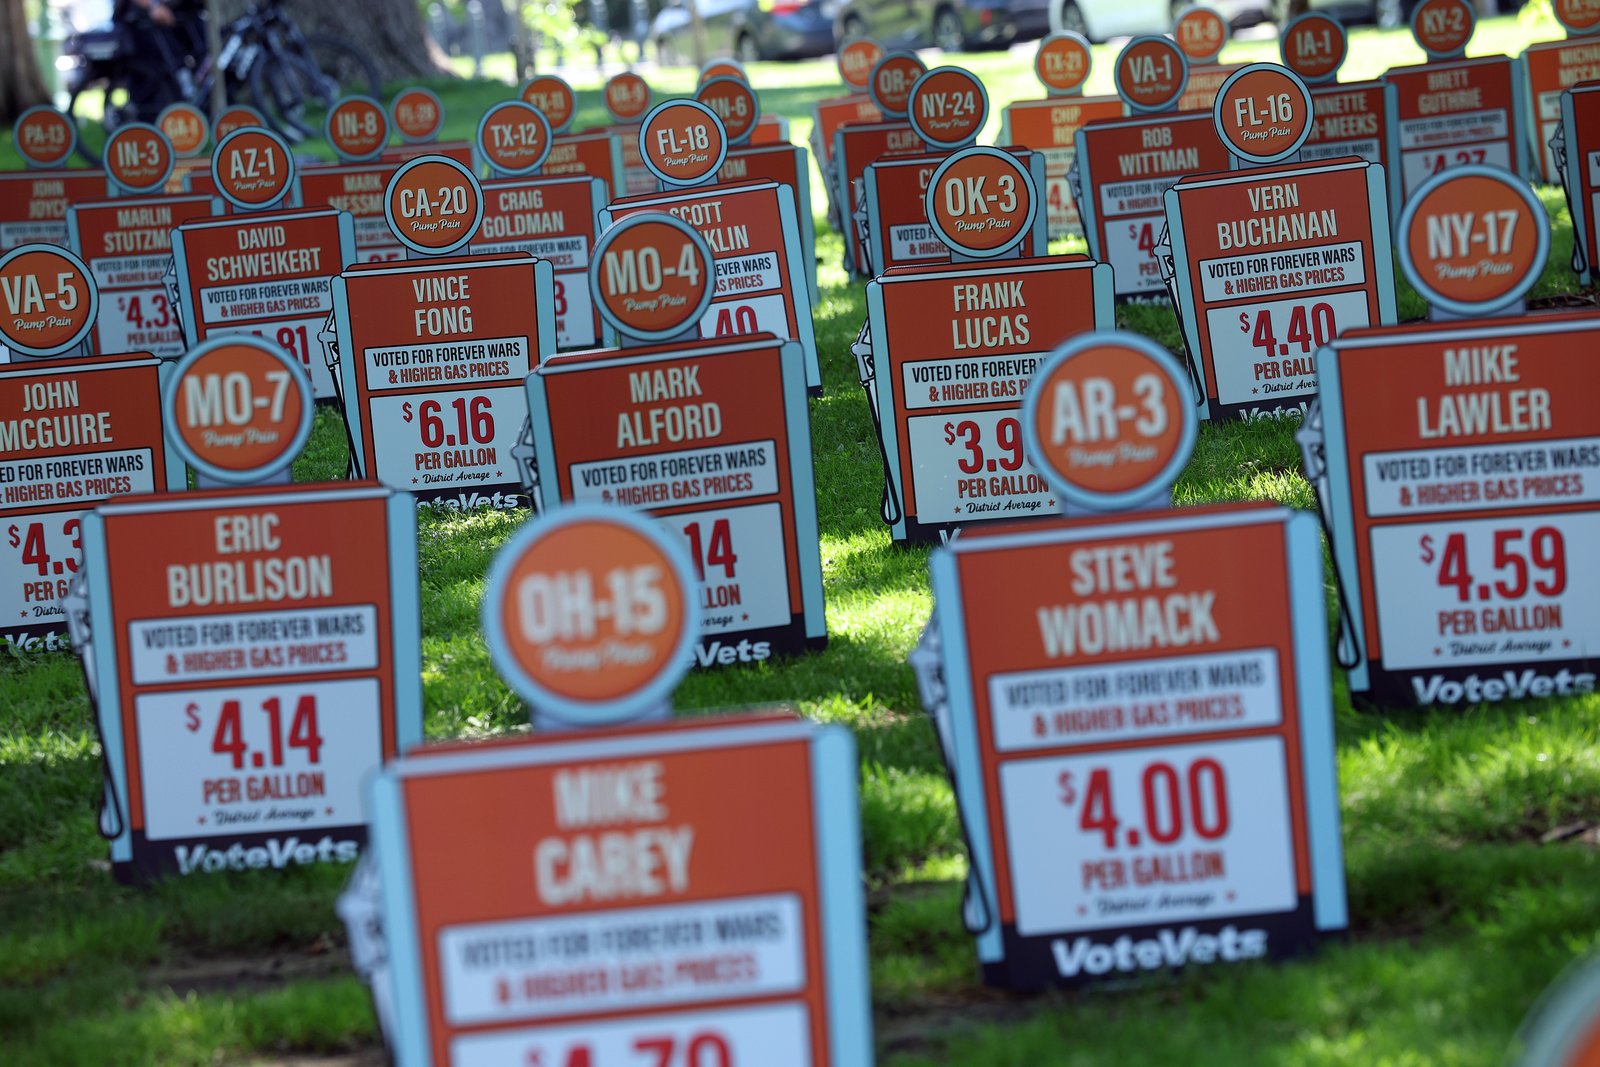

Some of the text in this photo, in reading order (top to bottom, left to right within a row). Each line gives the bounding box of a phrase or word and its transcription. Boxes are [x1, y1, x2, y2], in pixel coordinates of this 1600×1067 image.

[1422, 7, 1465, 35] KY-2
[1296, 30, 1332, 57] IA-1
[1128, 54, 1172, 84] VA-1
[1427, 69, 1470, 91] BRETT
[921, 91, 976, 118] NY-24
[1051, 107, 1081, 124] CHIP
[1234, 93, 1294, 128] FL-16
[1418, 88, 1483, 114] GUTHRIE
[24, 124, 65, 145] PA-13
[337, 111, 378, 137] IN-8
[490, 122, 539, 149] TX-12
[1142, 127, 1172, 148] ROB
[1241, 126, 1291, 141] Pump Pain
[117, 140, 160, 168] IN-3
[656, 124, 709, 156] FL-18
[230, 147, 276, 181] AZ-1
[664, 153, 709, 167] Pump Pain
[1118, 148, 1199, 176] WITTMAN
[32, 181, 64, 198] JOHN
[234, 178, 276, 191] Pump Pain
[343, 174, 383, 192] MARK
[945, 175, 1017, 217] OK-3
[1248, 183, 1300, 212] VERN
[400, 186, 468, 219] CA-20
[499, 190, 543, 212] CRAIG
[117, 208, 172, 229] MARLIN
[410, 218, 461, 233] Pump Pain
[482, 211, 565, 239] GOLDMAN
[955, 218, 1011, 233] Pump Pain
[1217, 209, 1338, 250] BUCHANAN
[237, 226, 286, 251] DAVID
[556, 240, 583, 252] WARS
[897, 227, 927, 242] VOTED
[1427, 209, 1520, 260] NY-17
[206, 247, 322, 282] SCHWEIKERT
[605, 243, 699, 296] MO-4
[741, 257, 772, 273] WARS
[1208, 247, 1356, 279] VOTED FOR FOREVER WARS
[1434, 259, 1513, 281] Pump Pain
[1, 272, 78, 316] VA-5
[207, 279, 330, 304] VOTED FOR FOREVER WARS
[412, 275, 471, 304] VINCE
[729, 273, 764, 292] PRICES
[1236, 266, 1346, 294] HIGHER GAS PRICES
[230, 296, 321, 317] HIGHER GAS PRICES
[624, 294, 687, 312] Pump Pain
[953, 280, 1026, 312] FRANK
[13, 315, 72, 331] Pump Pain
[414, 305, 473, 337] FONG
[952, 314, 1030, 350] LUCAS
[373, 342, 521, 368] VOTED FOR FOREVER WARS
[1444, 344, 1520, 387] MIKE
[400, 361, 510, 384] HIGHER GAS PRICES
[629, 364, 702, 404] MARK
[912, 363, 979, 383] VOTED FOR
[1254, 360, 1281, 381] PER
[23, 380, 79, 412] JOHN
[184, 371, 292, 428] MO-7
[943, 380, 1017, 401] HIGHER GAS
[1262, 380, 1295, 394] District
[402, 395, 495, 449] $6.16
[1052, 373, 1168, 446] AR-3
[1417, 388, 1552, 439] LAWLER
[0, 412, 113, 452] MCGUIRE
[617, 402, 722, 449] ALFORD
[19, 464, 44, 482] FOR
[46, 458, 104, 479] FOREVER
[105, 455, 144, 473] WARS
[415, 447, 497, 471] PER GALLON
[581, 448, 766, 488] VOTED FOR FOREVER WARS
[1375, 445, 1600, 482] VOTED FOR FOREVER WARS
[5, 476, 132, 504] HIGHER GAS PRICES
[422, 471, 491, 484] District Average
[616, 473, 753, 508] HIGHER GAS PRICES
[958, 479, 986, 499] PER
[1417, 473, 1584, 507] HIGHER GAS PRICES
[966, 500, 1042, 514] District Average
[214, 513, 281, 555] ERIC
[1070, 540, 1177, 596] STEVE
[1419, 525, 1567, 602] $4.59
[23, 581, 54, 602] PER
[167, 555, 333, 607] BURLISON
[518, 563, 668, 646] OH-15
[141, 612, 365, 649] VOTED FOR FOREVER WARS
[1037, 591, 1219, 658] WOMACK
[1438, 604, 1563, 636] PER GALLON
[183, 641, 348, 674] HIGHER GAS PRICES
[1005, 658, 1265, 709] VOTED FOREVER WARS
[1411, 668, 1597, 706] VoteVets
[185, 694, 324, 770] $4.14
[203, 772, 325, 805] PER GALLON
[553, 761, 669, 829] MIKE
[1057, 757, 1230, 850] $4.00
[174, 836, 359, 877] VoteVets
[533, 826, 695, 907] CAREY
[1081, 850, 1226, 891] PER GALLON
[1052, 924, 1268, 978] VoteVets
